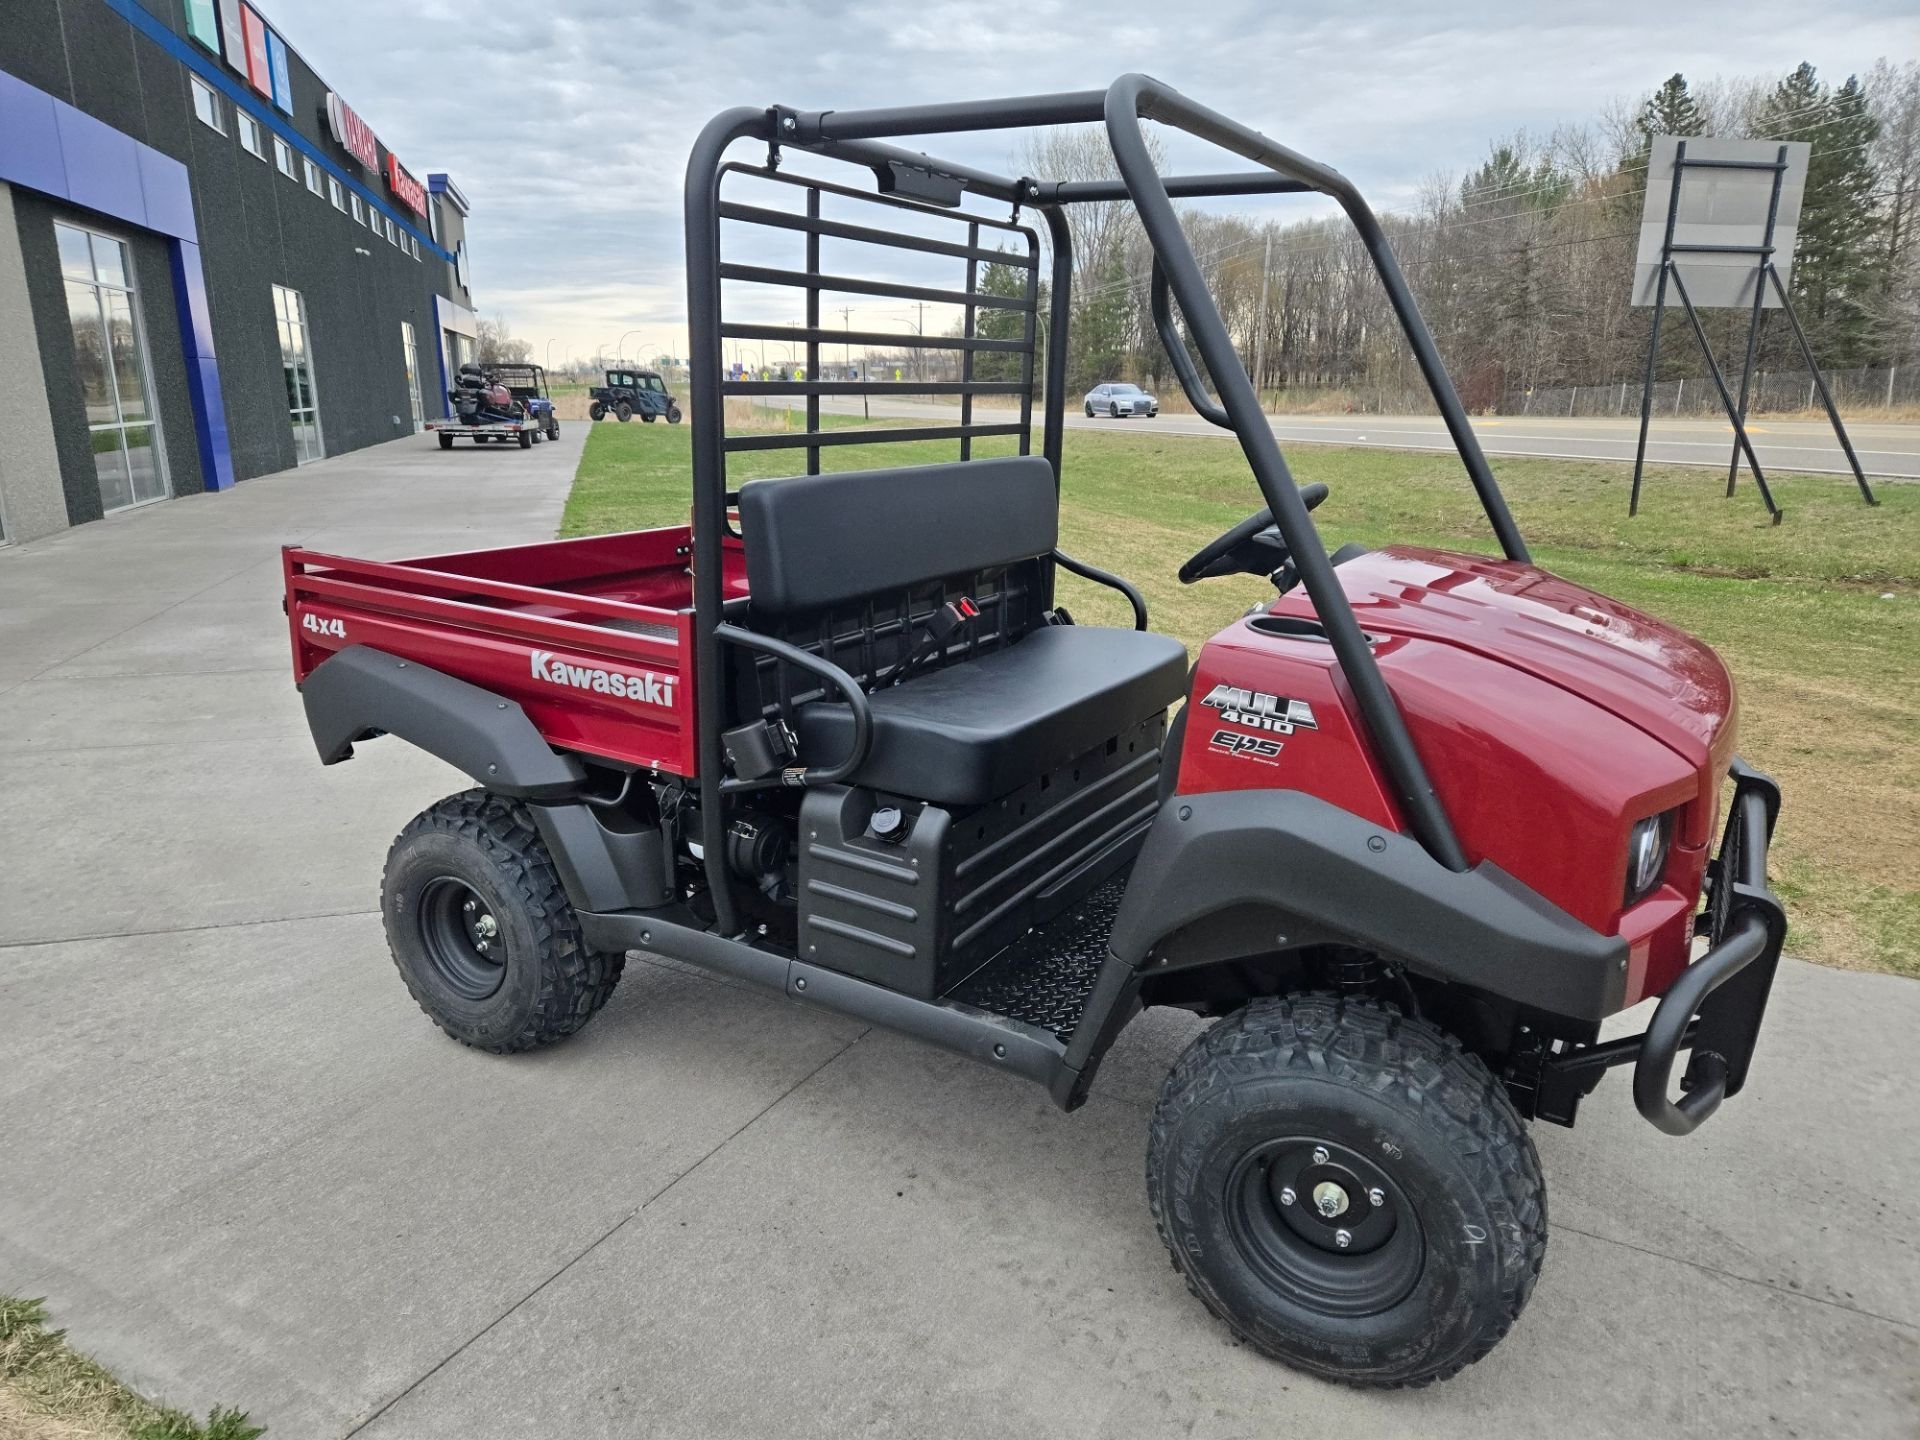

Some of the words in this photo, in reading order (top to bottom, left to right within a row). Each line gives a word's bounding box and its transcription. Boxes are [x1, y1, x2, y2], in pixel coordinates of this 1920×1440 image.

[302, 612, 347, 639] 4x4
[530, 649, 674, 708] Kawasaki
[1200, 684, 1319, 730] MULE
[1221, 711, 1295, 735] 4010
